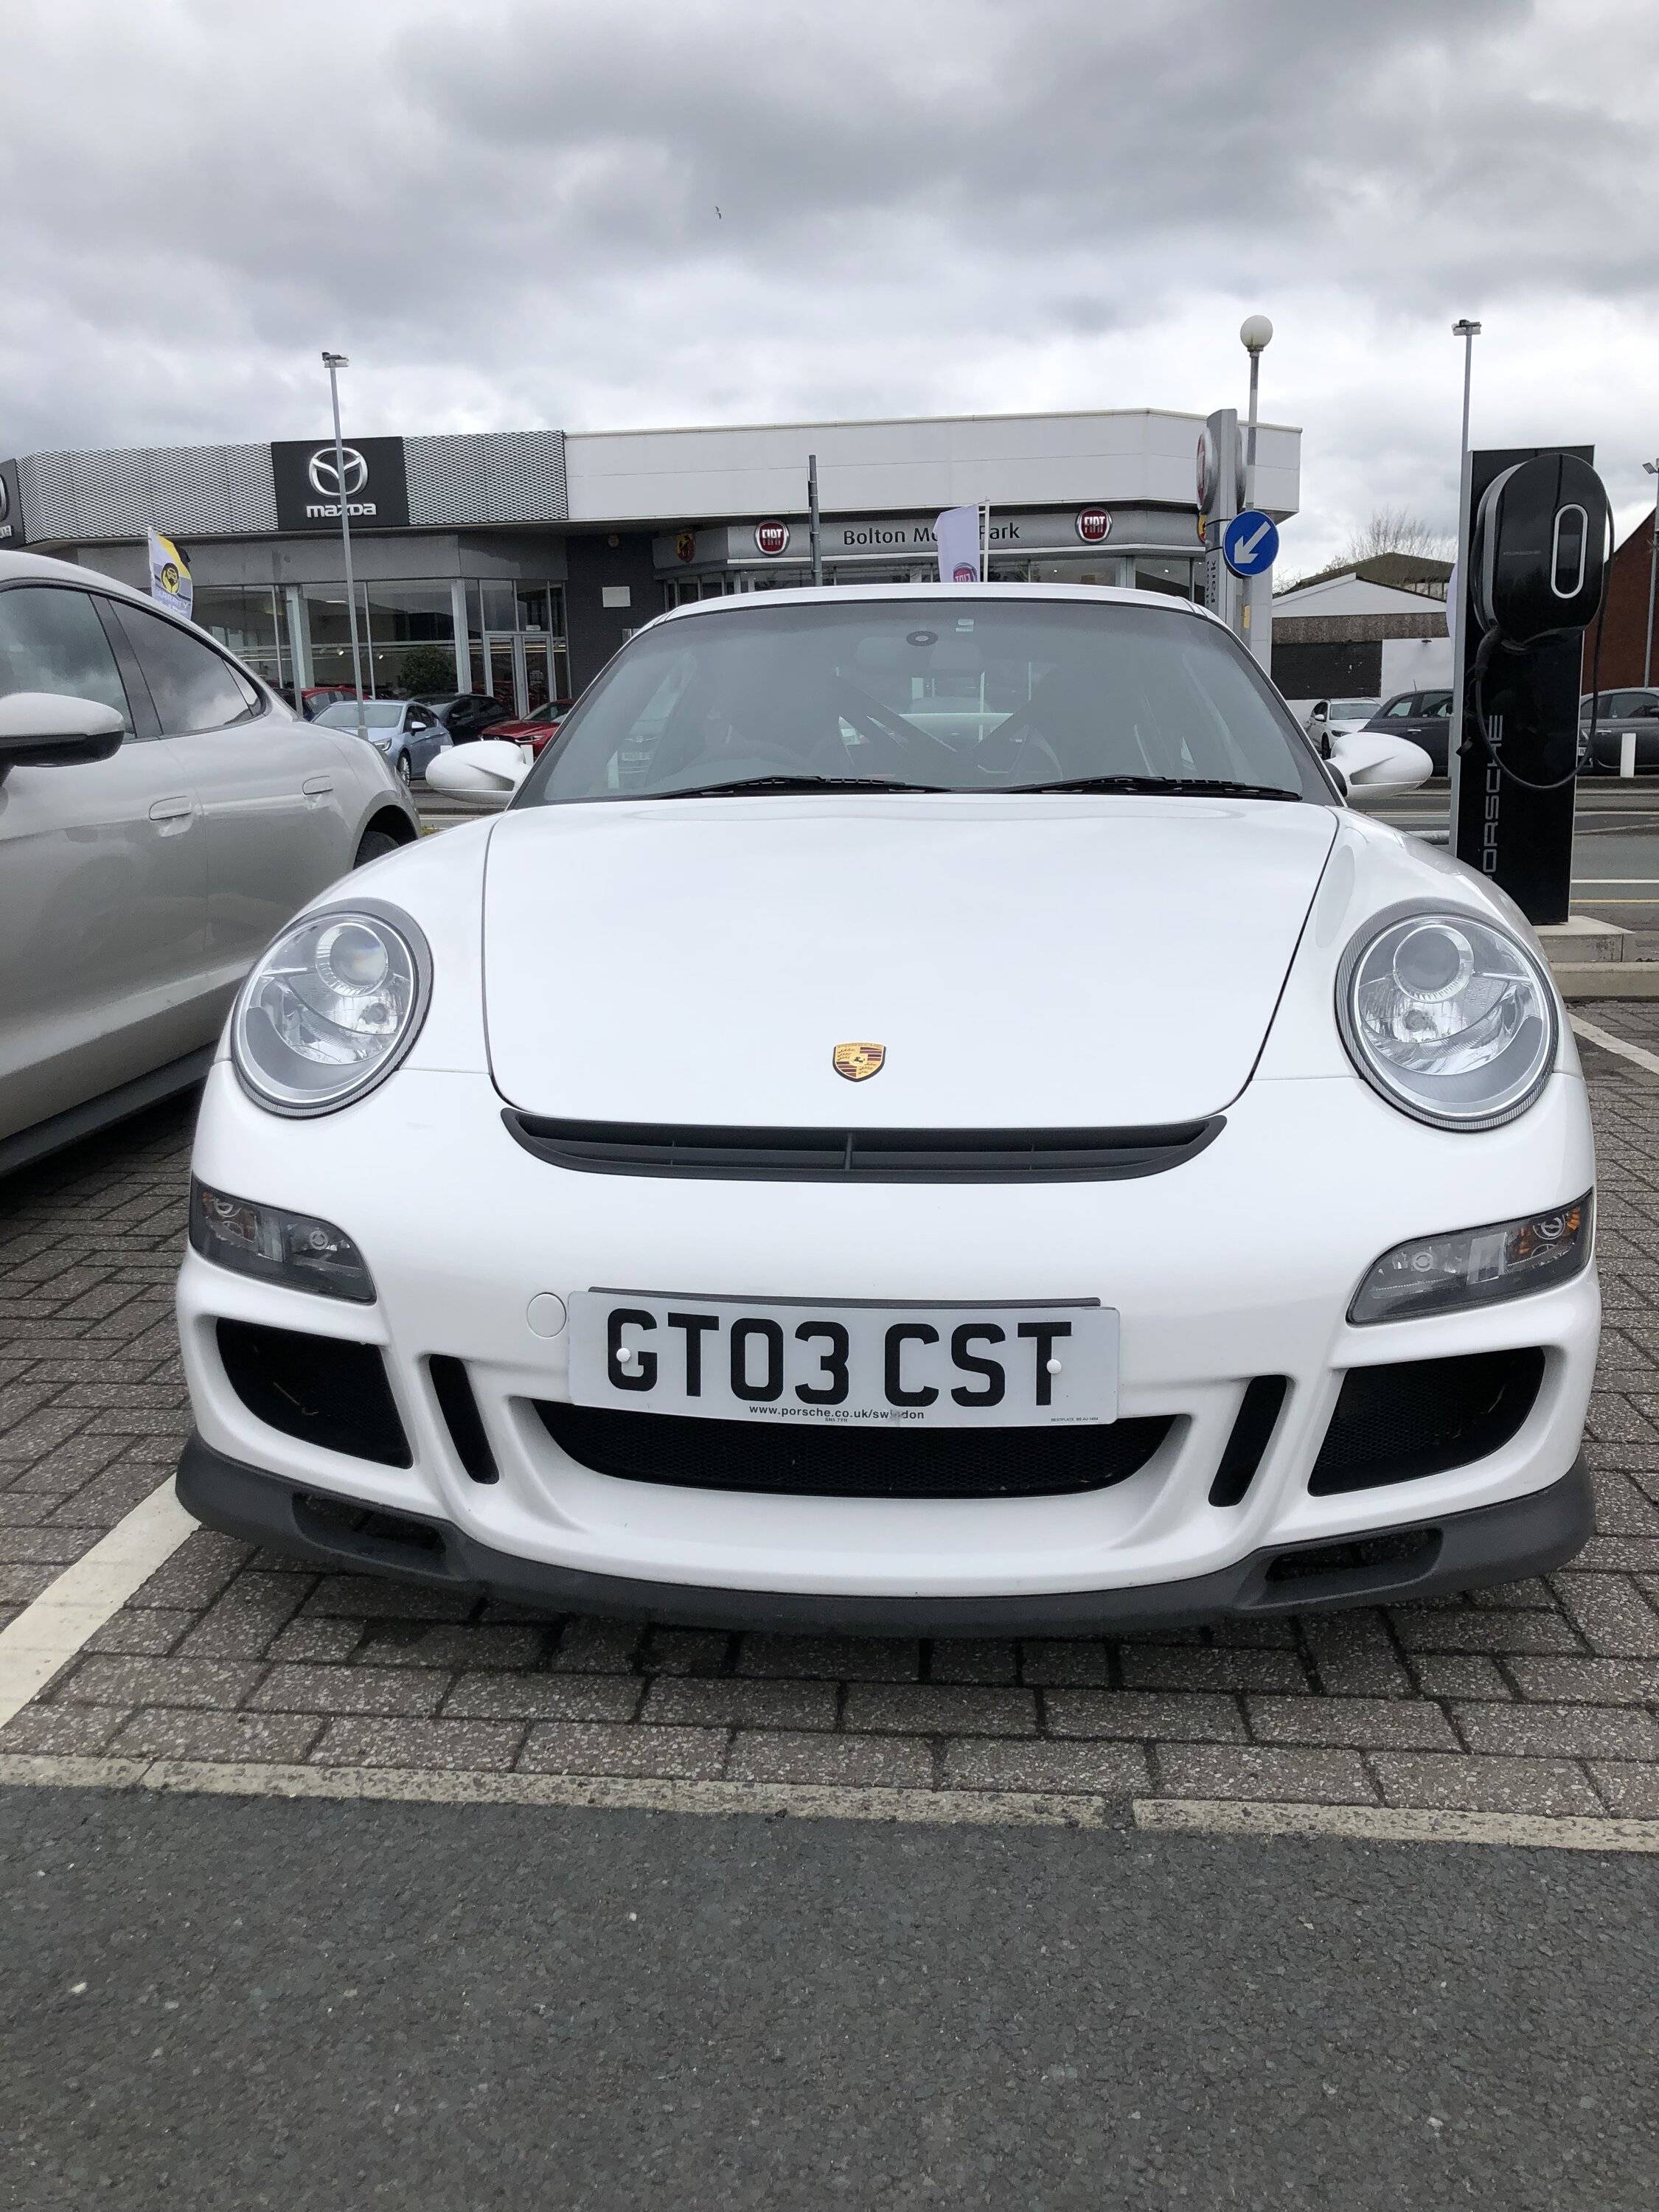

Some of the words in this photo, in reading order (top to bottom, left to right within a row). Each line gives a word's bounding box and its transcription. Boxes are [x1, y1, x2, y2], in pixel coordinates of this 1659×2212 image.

[306, 503, 377, 518] mazda
[1085, 516, 1105, 533] FIAT
[762, 529, 783, 546] FIAT
[844, 527, 905, 545] Bolton
[1482, 714, 1503, 881] ORSCHE
[607, 1307, 849, 1405] GT03
[884, 1321, 1072, 1408] CST
[749, 1405, 925, 1420] www.porsche.co.uk/swdon
